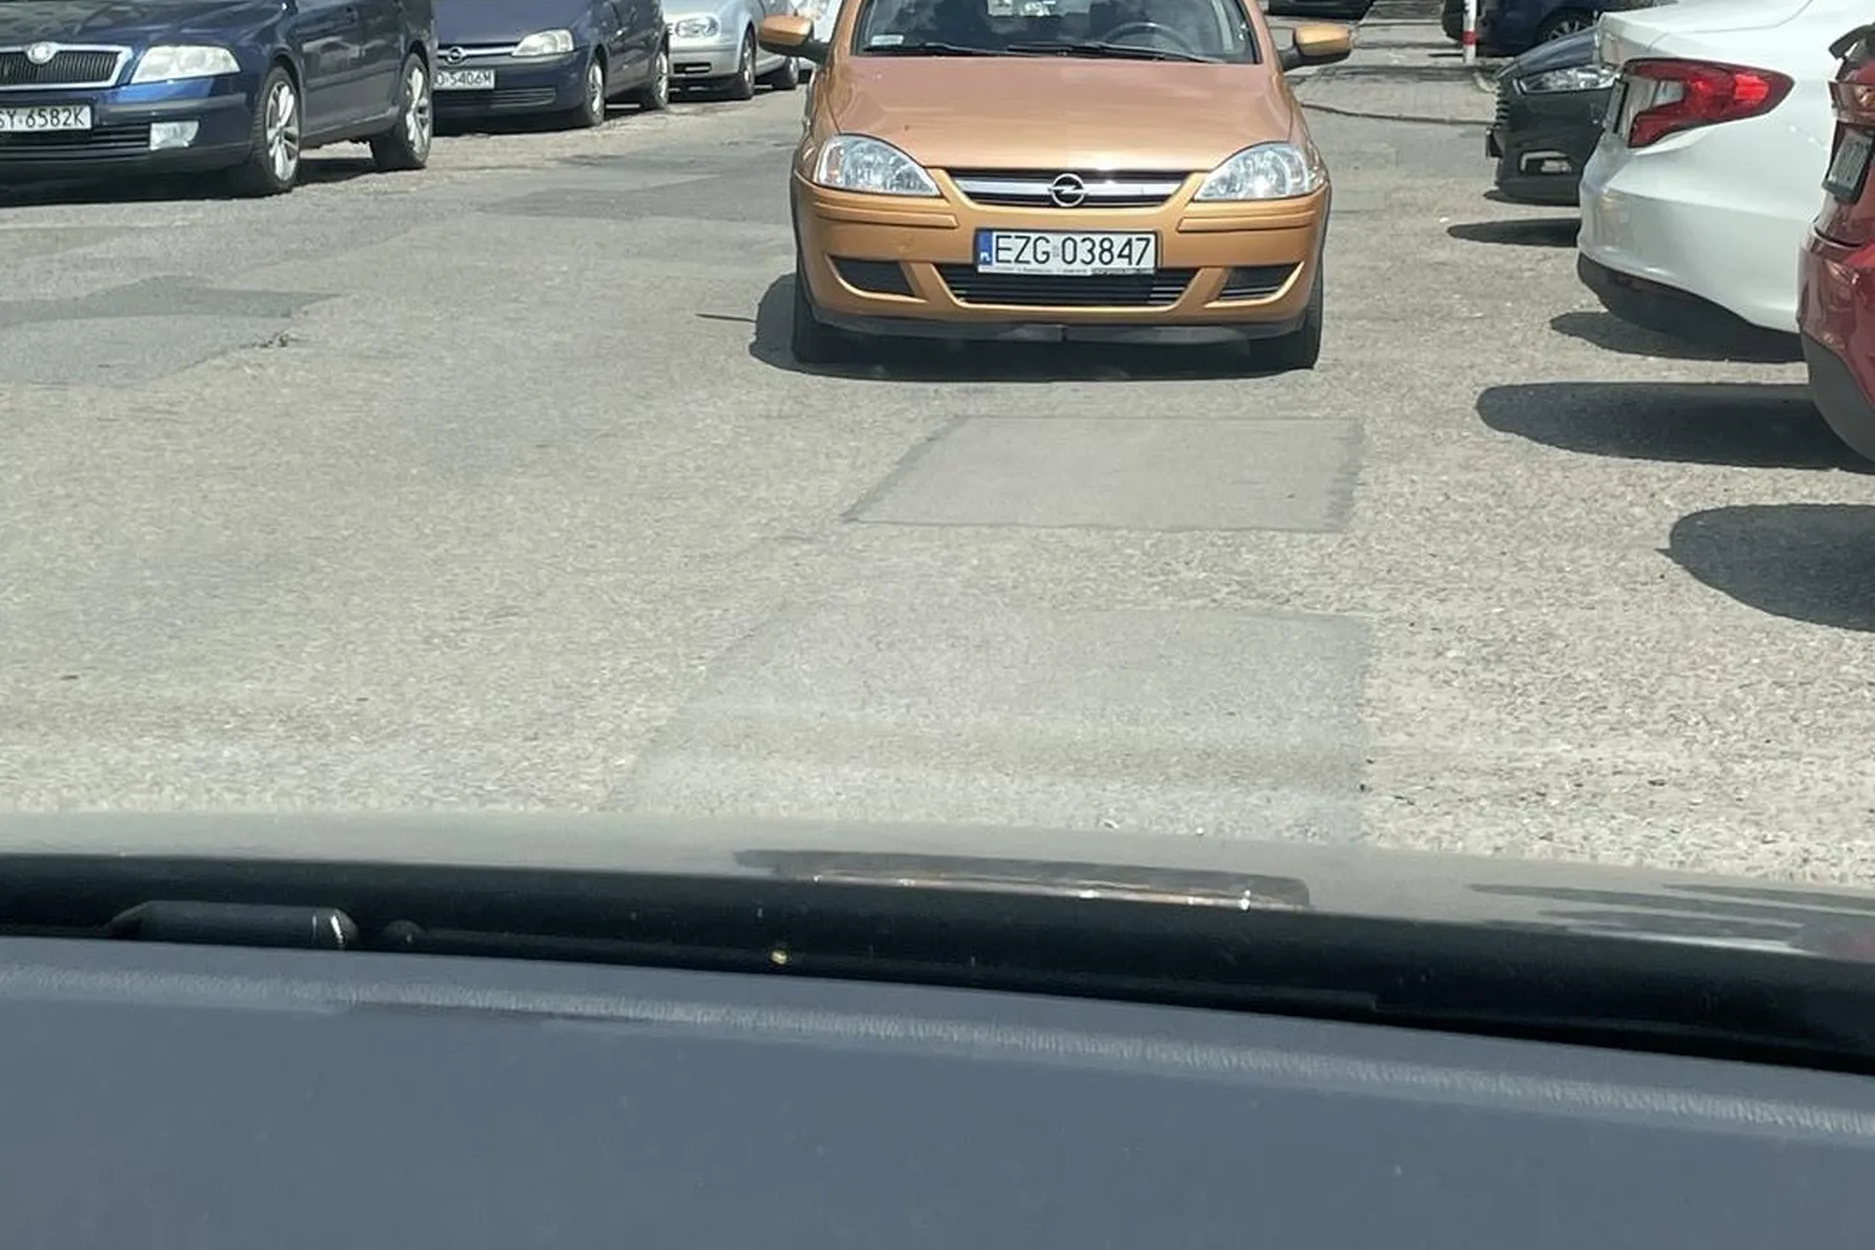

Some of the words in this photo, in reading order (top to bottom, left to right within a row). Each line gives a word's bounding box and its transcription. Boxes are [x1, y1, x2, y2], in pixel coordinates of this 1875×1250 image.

[25, 107, 85, 128] 6582K
[995, 235, 1050, 265] EZG
[1061, 236, 1152, 266] 03847
